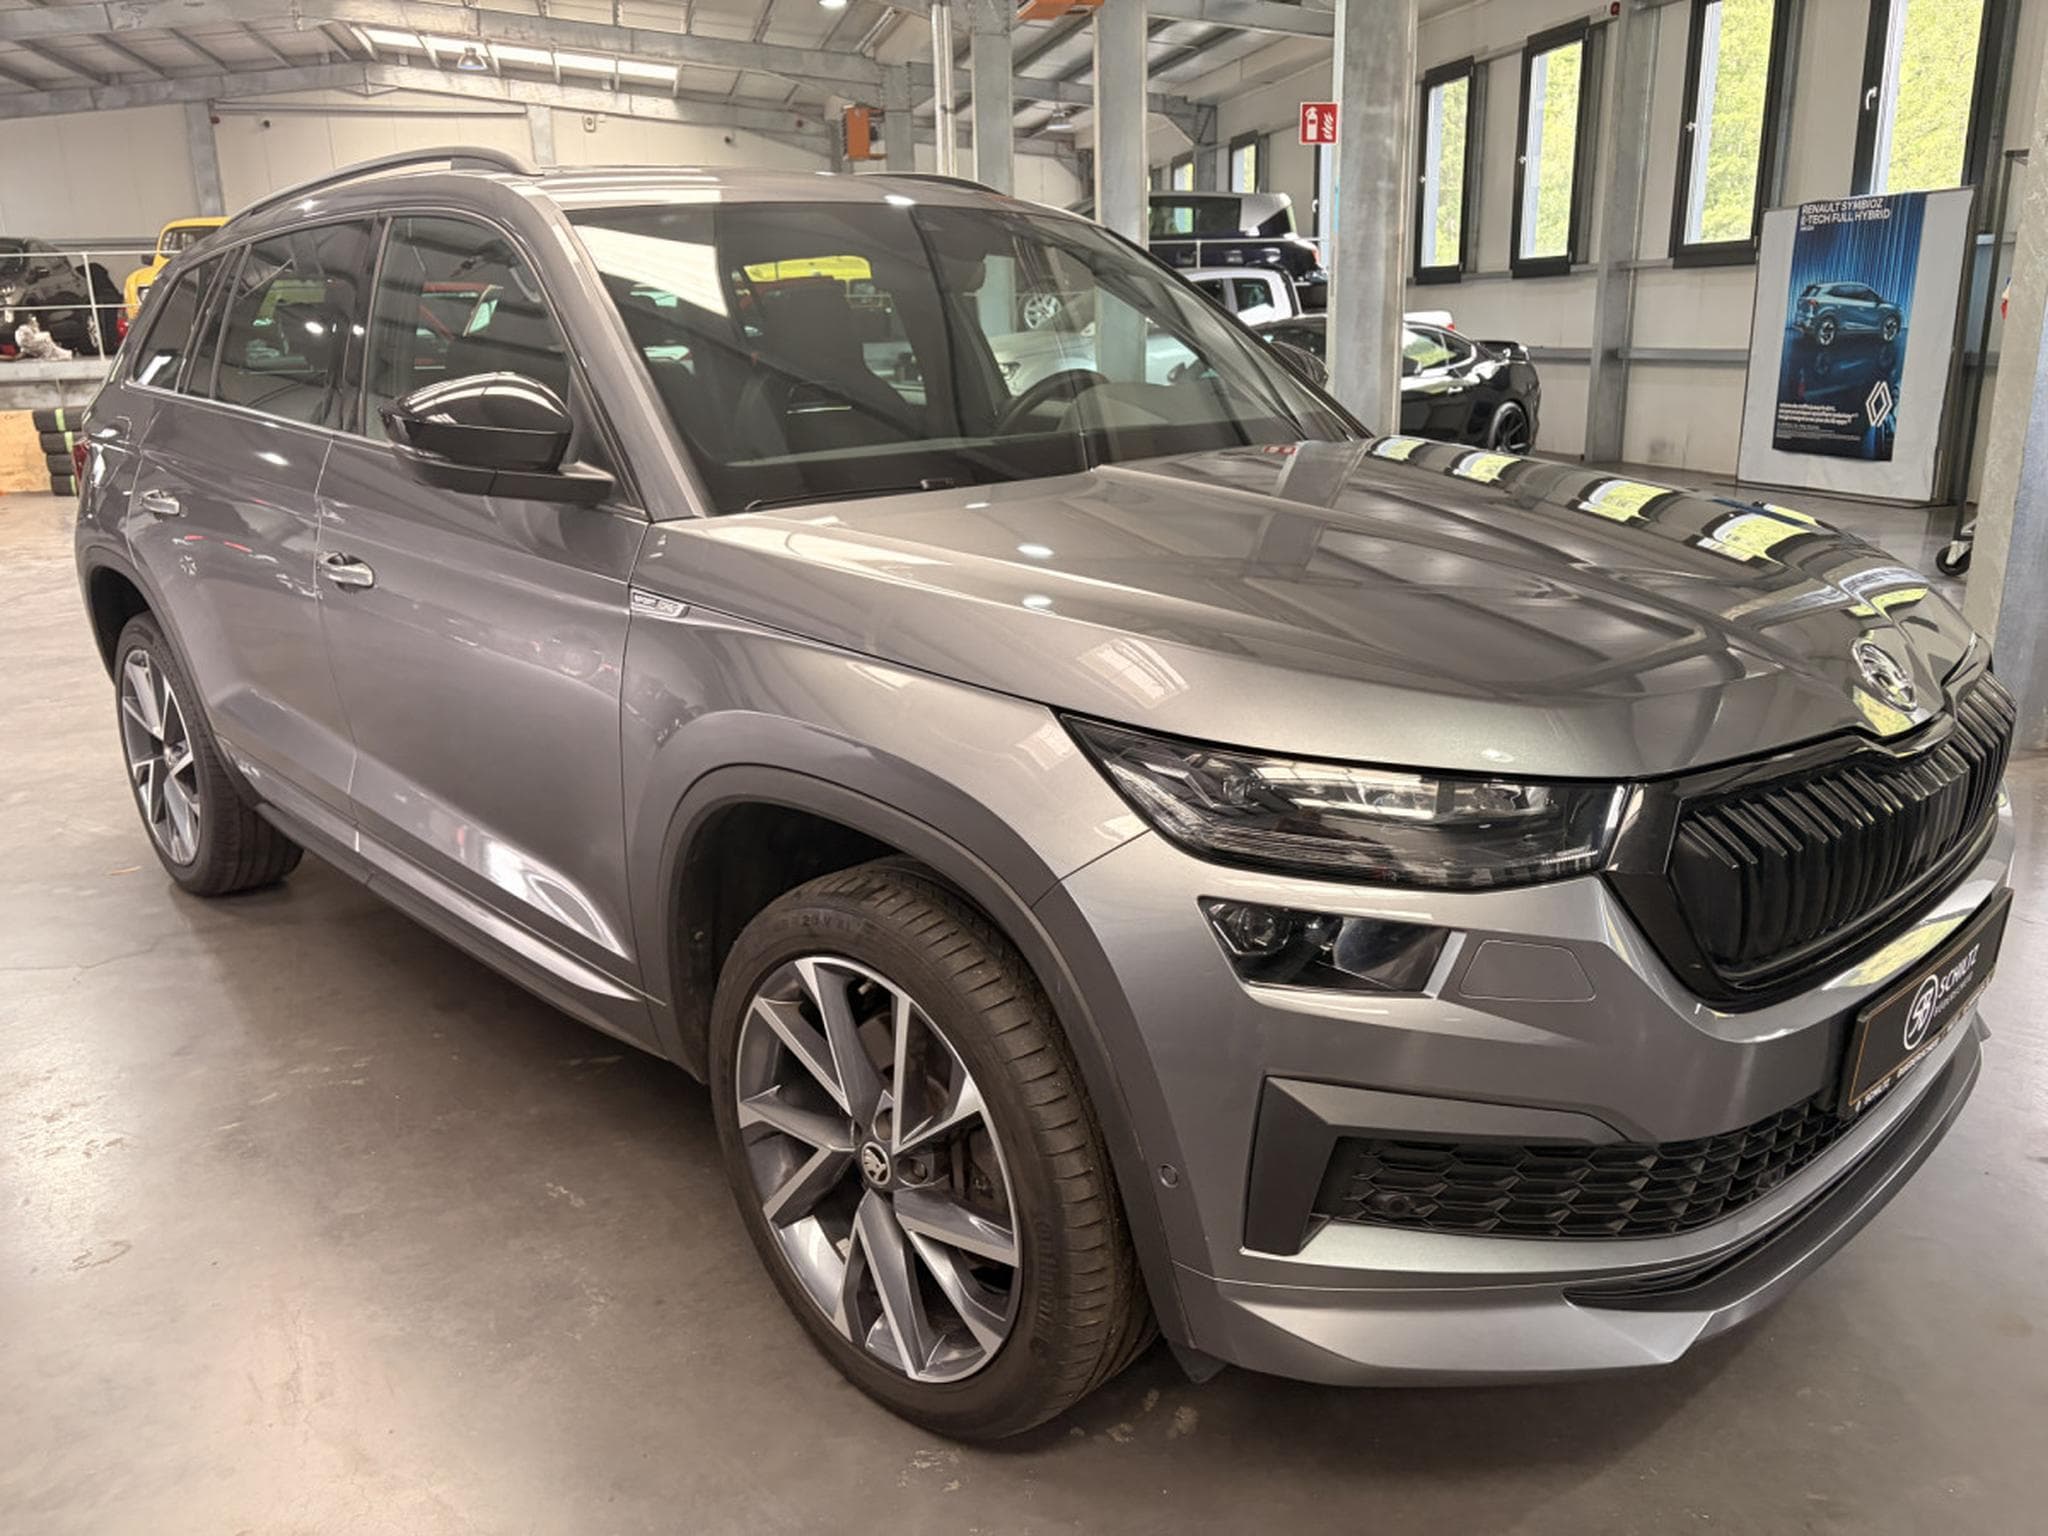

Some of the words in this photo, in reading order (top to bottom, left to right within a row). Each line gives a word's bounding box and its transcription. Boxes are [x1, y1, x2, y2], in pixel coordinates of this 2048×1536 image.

[1801, 202, 1840, 215] RENAULT
[1841, 197, 1884, 210] SYMBIOZ
[1801, 213, 1831, 226] E-TECH
[1832, 211, 1854, 223] FULL
[1855, 208, 1890, 222] HYBRID
